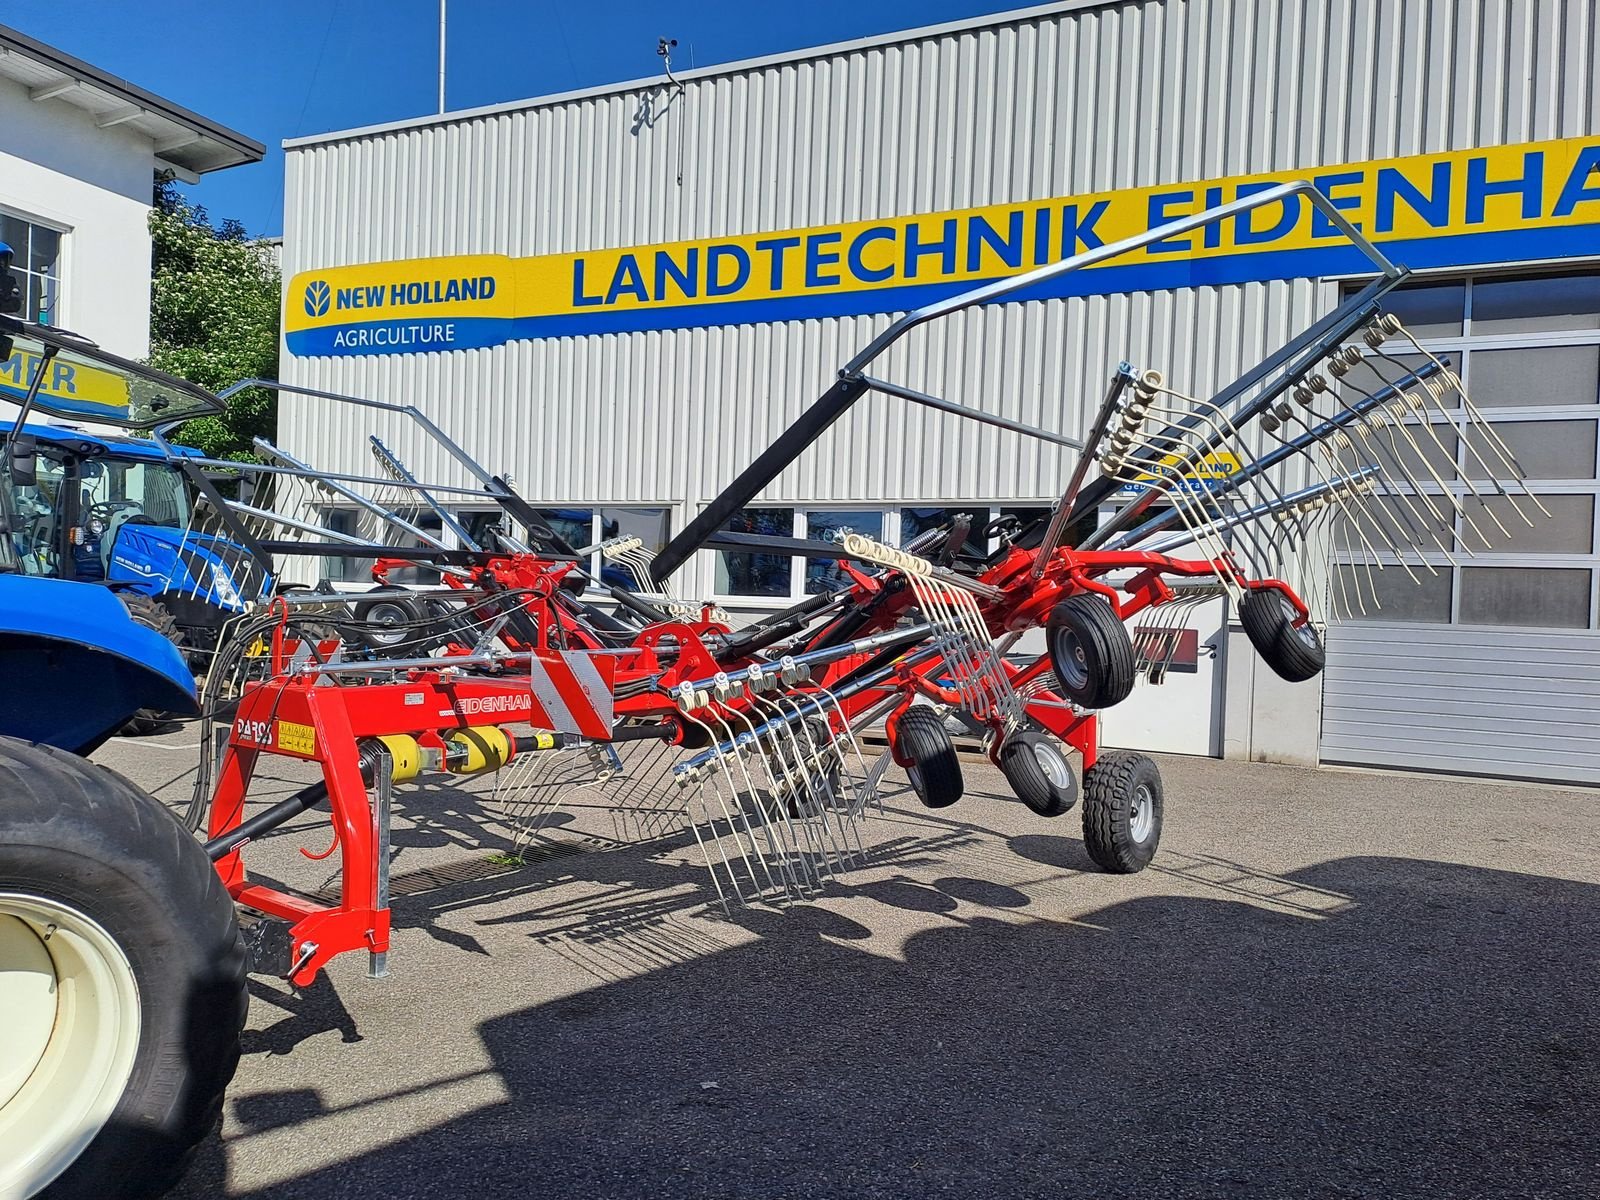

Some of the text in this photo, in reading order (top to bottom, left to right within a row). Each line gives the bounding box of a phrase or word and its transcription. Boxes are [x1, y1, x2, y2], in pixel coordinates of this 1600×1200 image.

[573, 200, 1111, 307] LANDTECHNIK
[336, 276, 496, 310] NEW HOLLAND
[333, 324, 455, 347] AGRICULTURE
